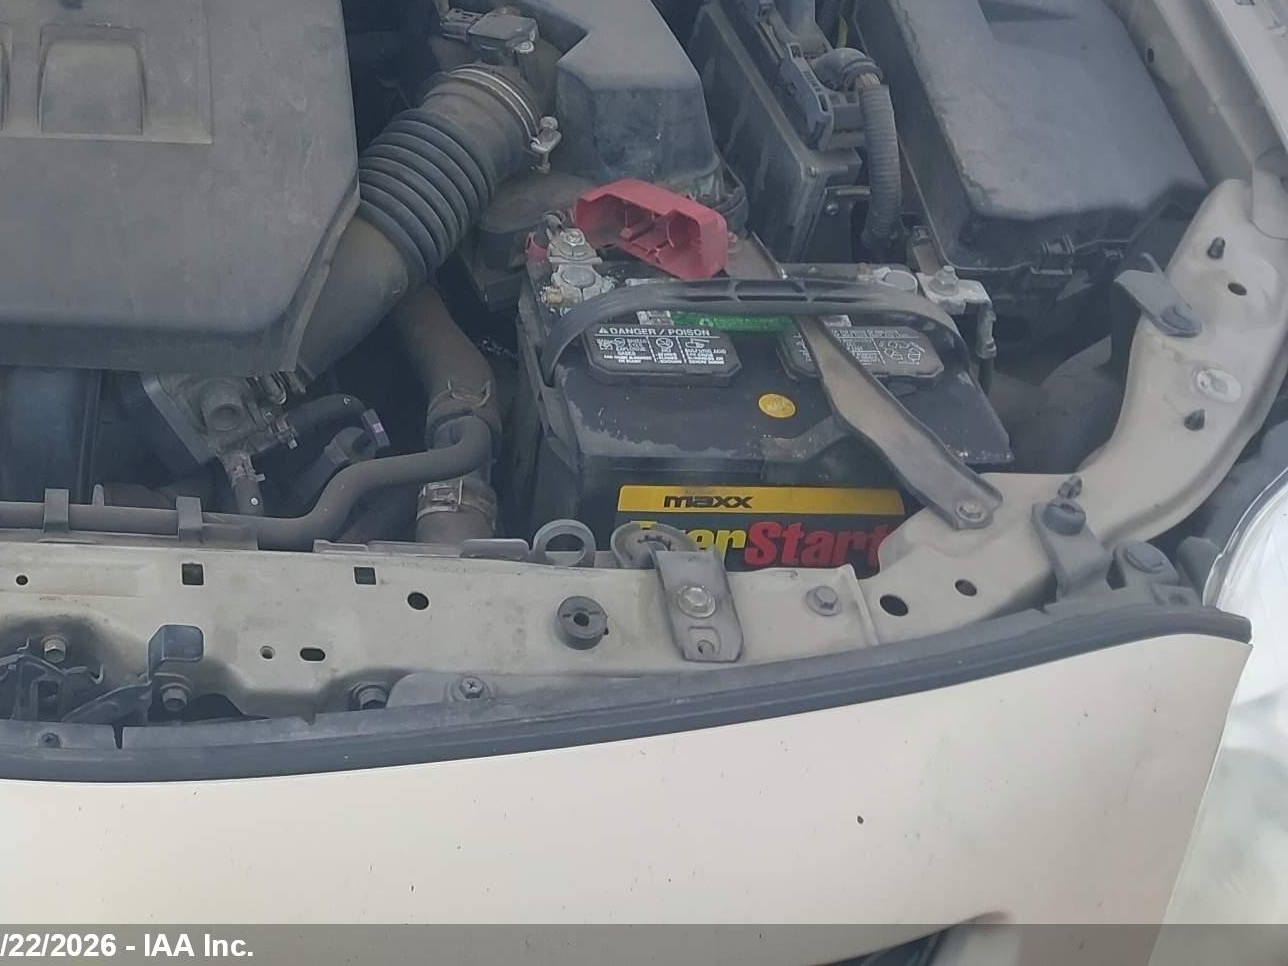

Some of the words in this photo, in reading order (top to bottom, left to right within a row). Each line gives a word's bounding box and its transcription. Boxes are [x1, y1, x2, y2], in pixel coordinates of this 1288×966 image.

[609, 327, 656, 336] DANGER
[667, 328, 710, 337] POISON
[663, 495, 754, 509] maxx
